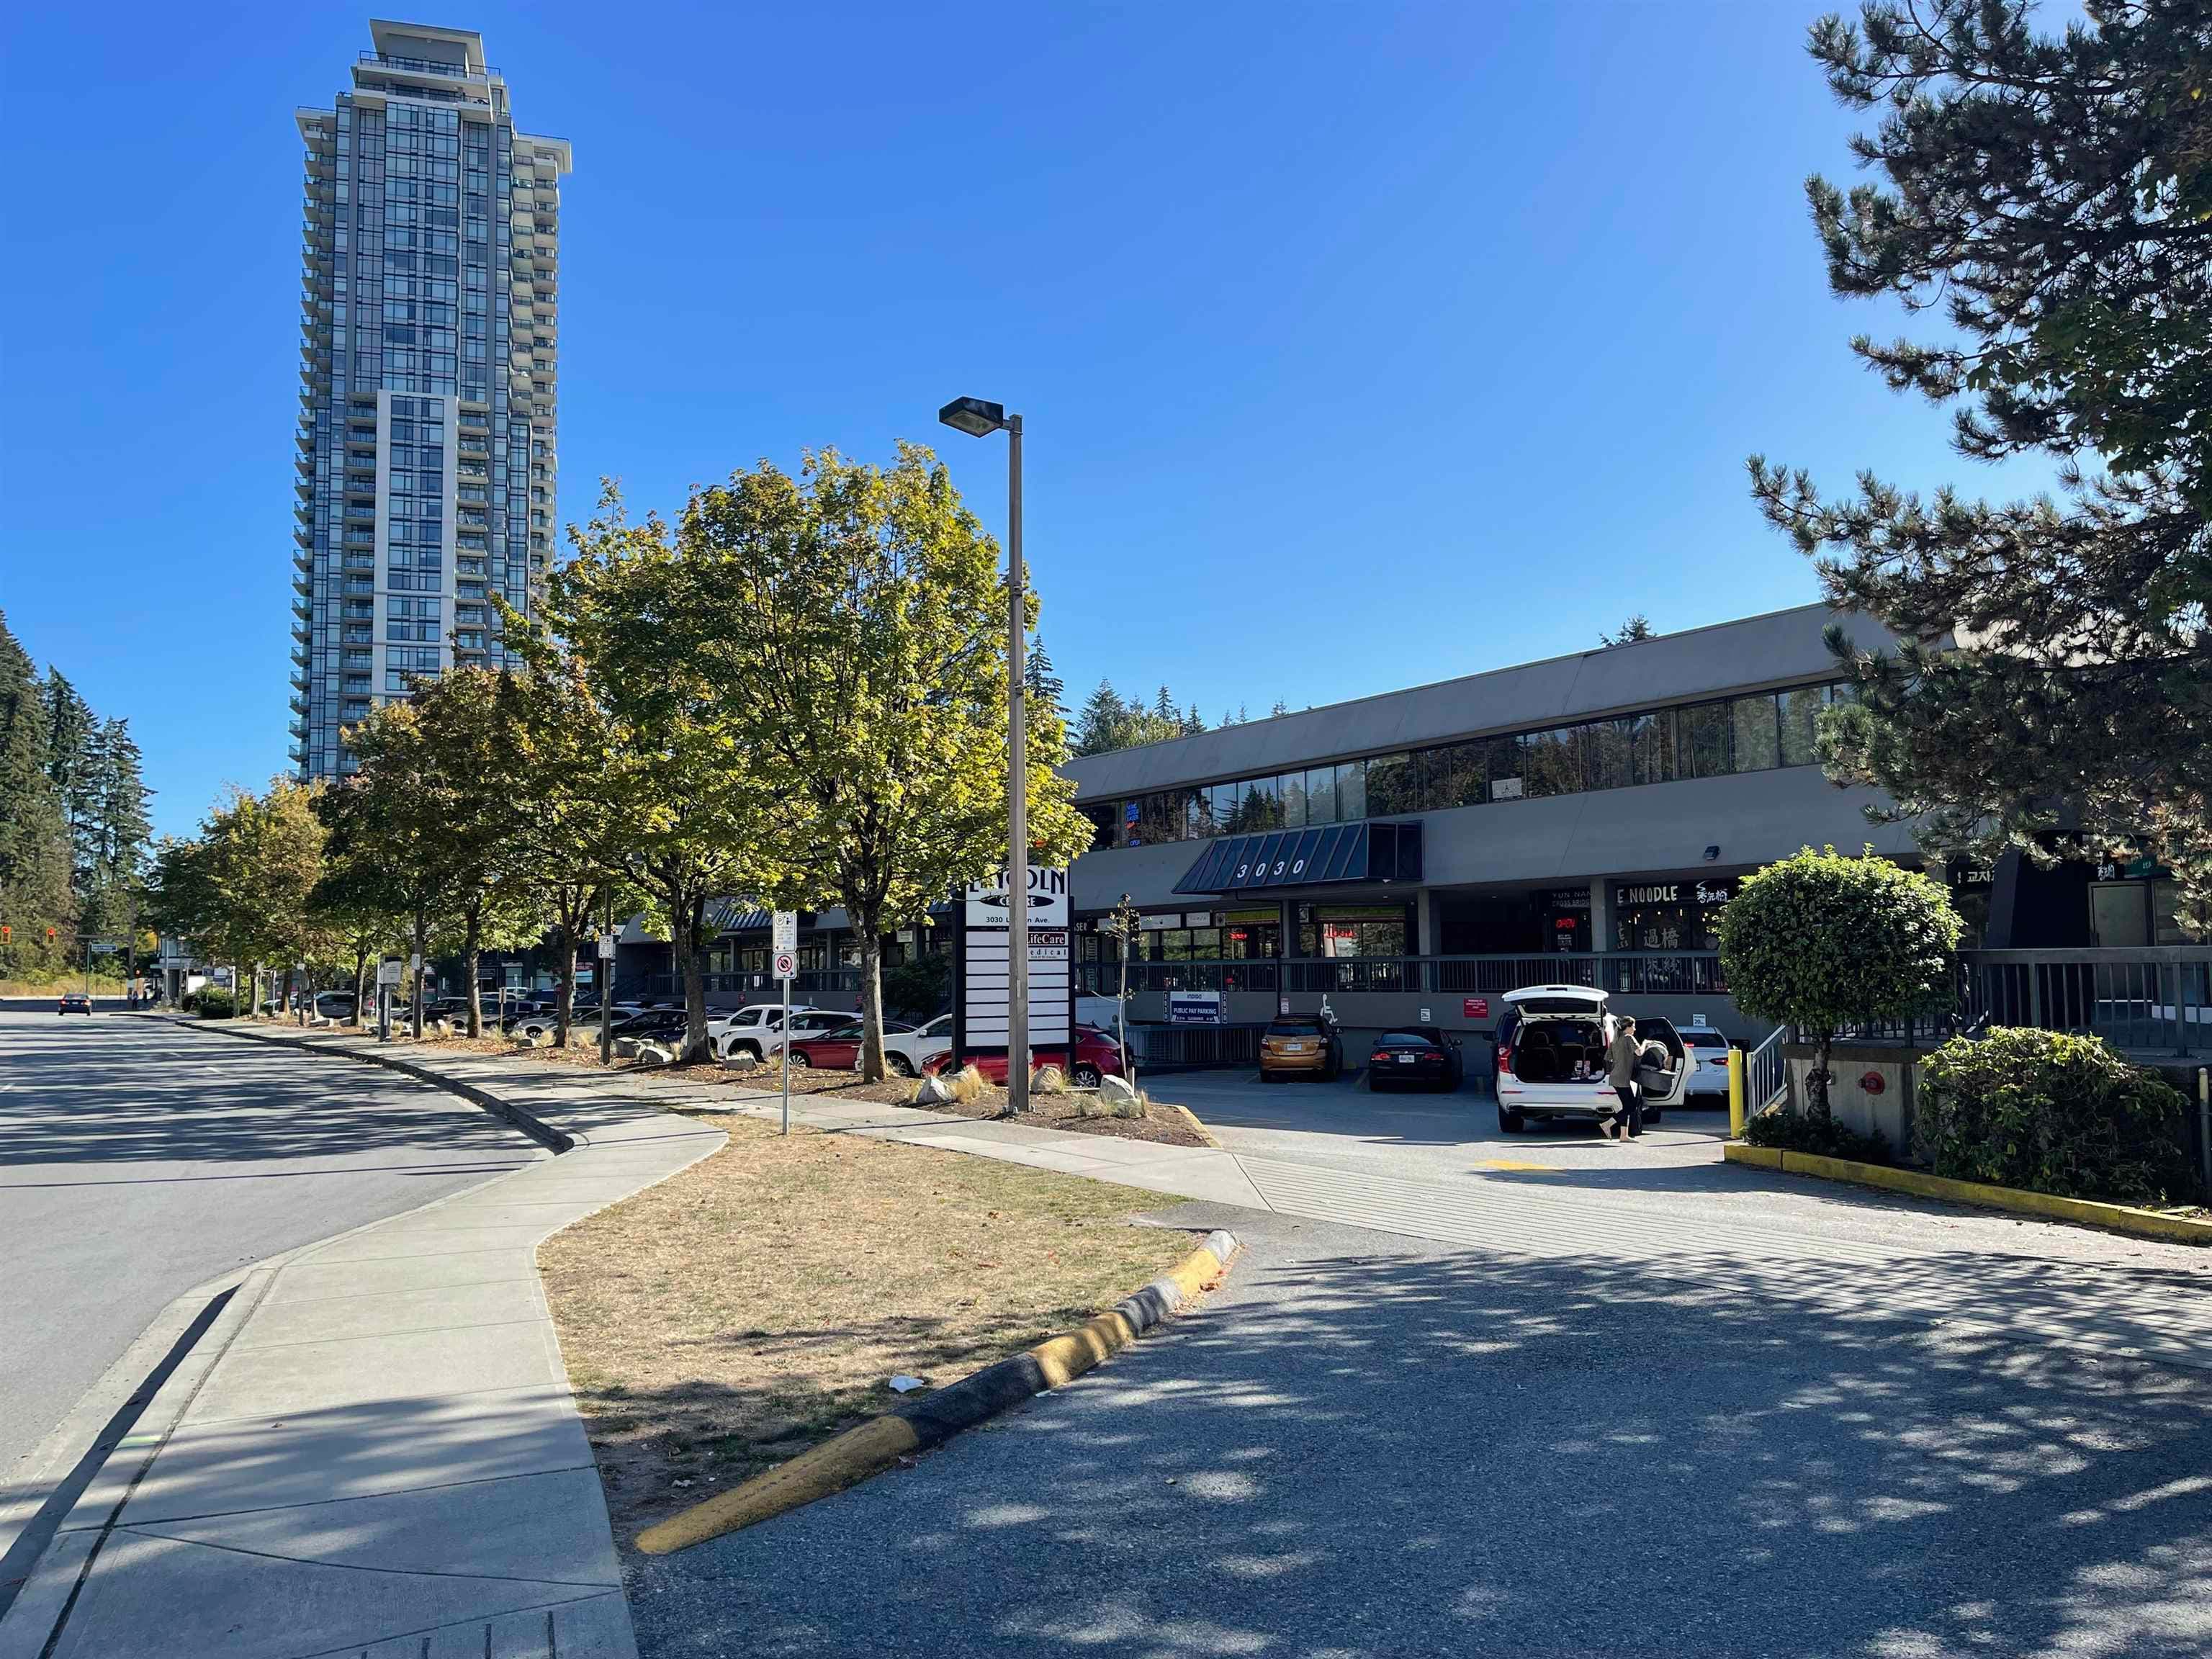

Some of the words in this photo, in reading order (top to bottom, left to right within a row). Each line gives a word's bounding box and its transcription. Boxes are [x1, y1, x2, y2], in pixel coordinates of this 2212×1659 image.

[1236, 859, 1304, 878] 3030
[1966, 870, 1994, 883] 교자
[1629, 886, 1678, 903] NOODLE
